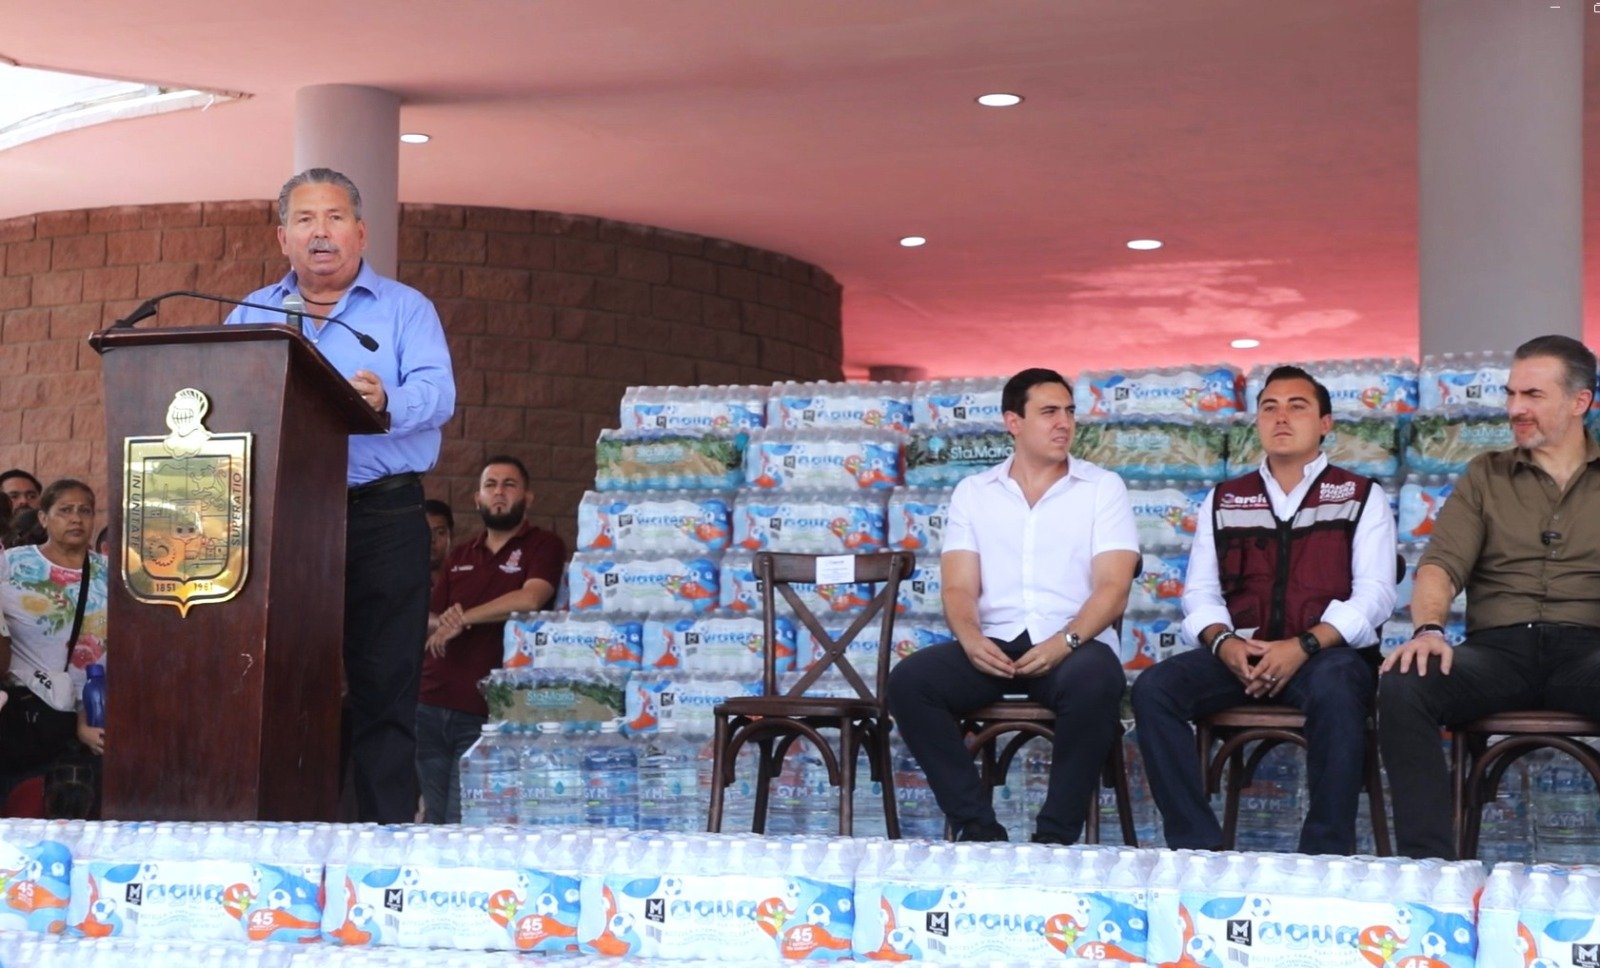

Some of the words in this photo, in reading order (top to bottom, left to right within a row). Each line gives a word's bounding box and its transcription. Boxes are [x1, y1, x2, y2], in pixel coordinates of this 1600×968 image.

[132, 474, 141, 490] IN
[231, 472, 242, 546] SUPERATIO
[130, 493, 141, 551] UNITATE
[156, 583, 176, 592] 1851
[17, 882, 34, 897] 45
[146, 883, 225, 907] agua
[407, 889, 489, 914] agua
[669, 898, 757, 925] agua
[252, 911, 273, 926] 45
[521, 917, 543, 932] 45
[954, 912, 1046, 937] agua
[790, 927, 813, 942] 45
[1258, 921, 1359, 950] agua
[1083, 944, 1106, 959] 45
